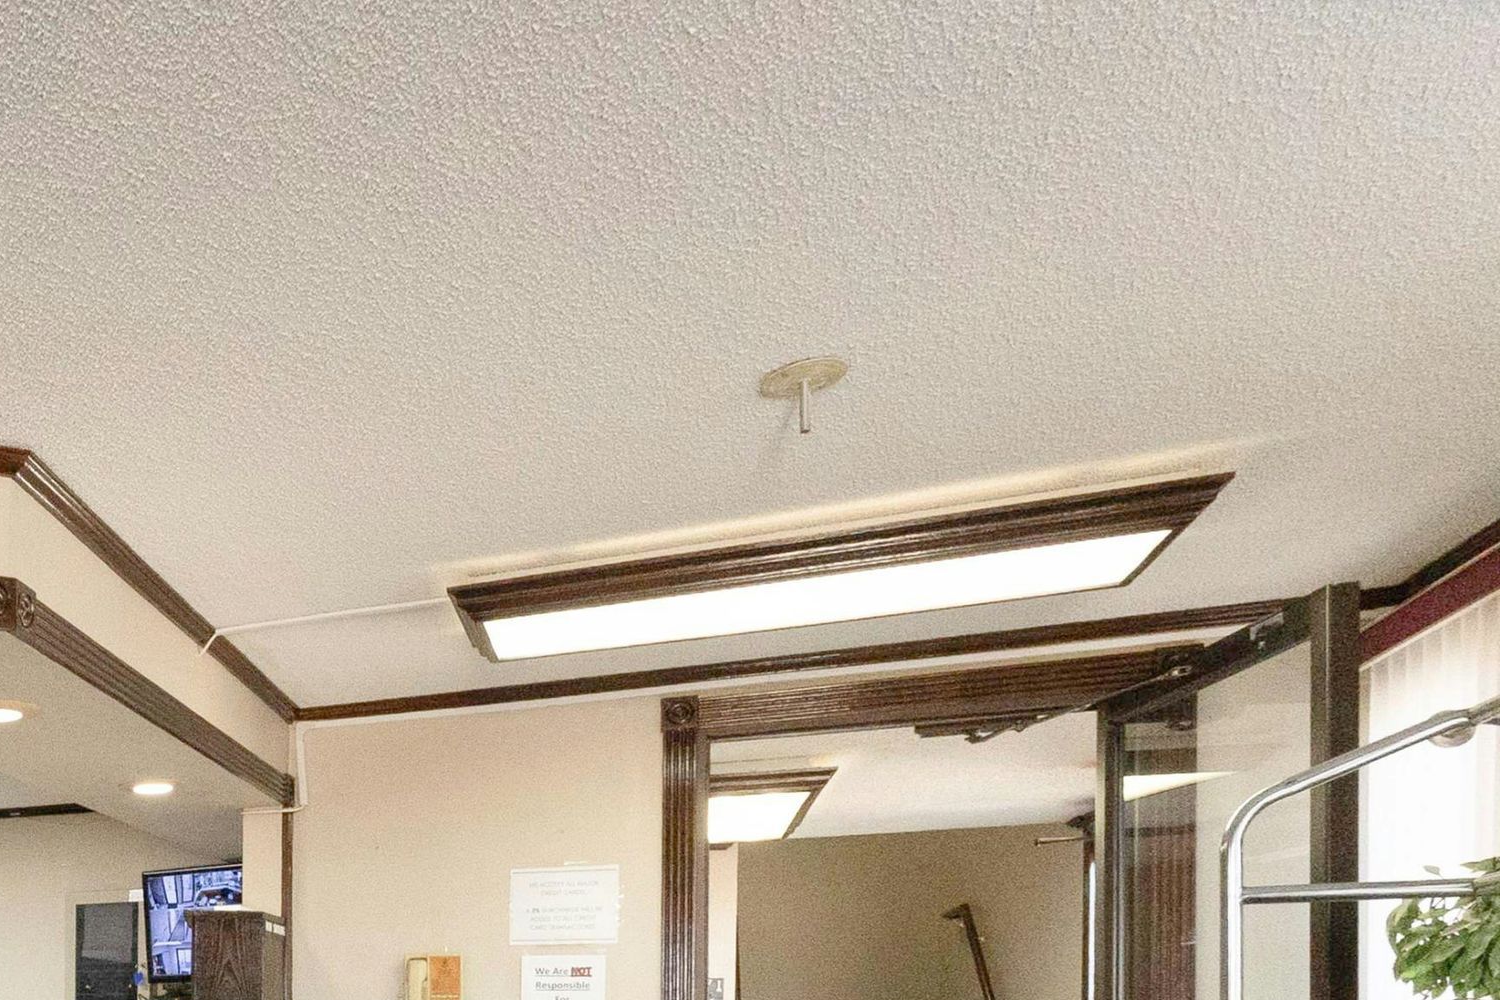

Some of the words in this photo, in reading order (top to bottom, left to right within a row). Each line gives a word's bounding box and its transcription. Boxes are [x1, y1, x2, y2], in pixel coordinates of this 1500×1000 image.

[535, 967, 549, 975] We
[552, 967, 569, 975] Are
[571, 967, 592, 977] NOT
[535, 981, 590, 991] Responsible
